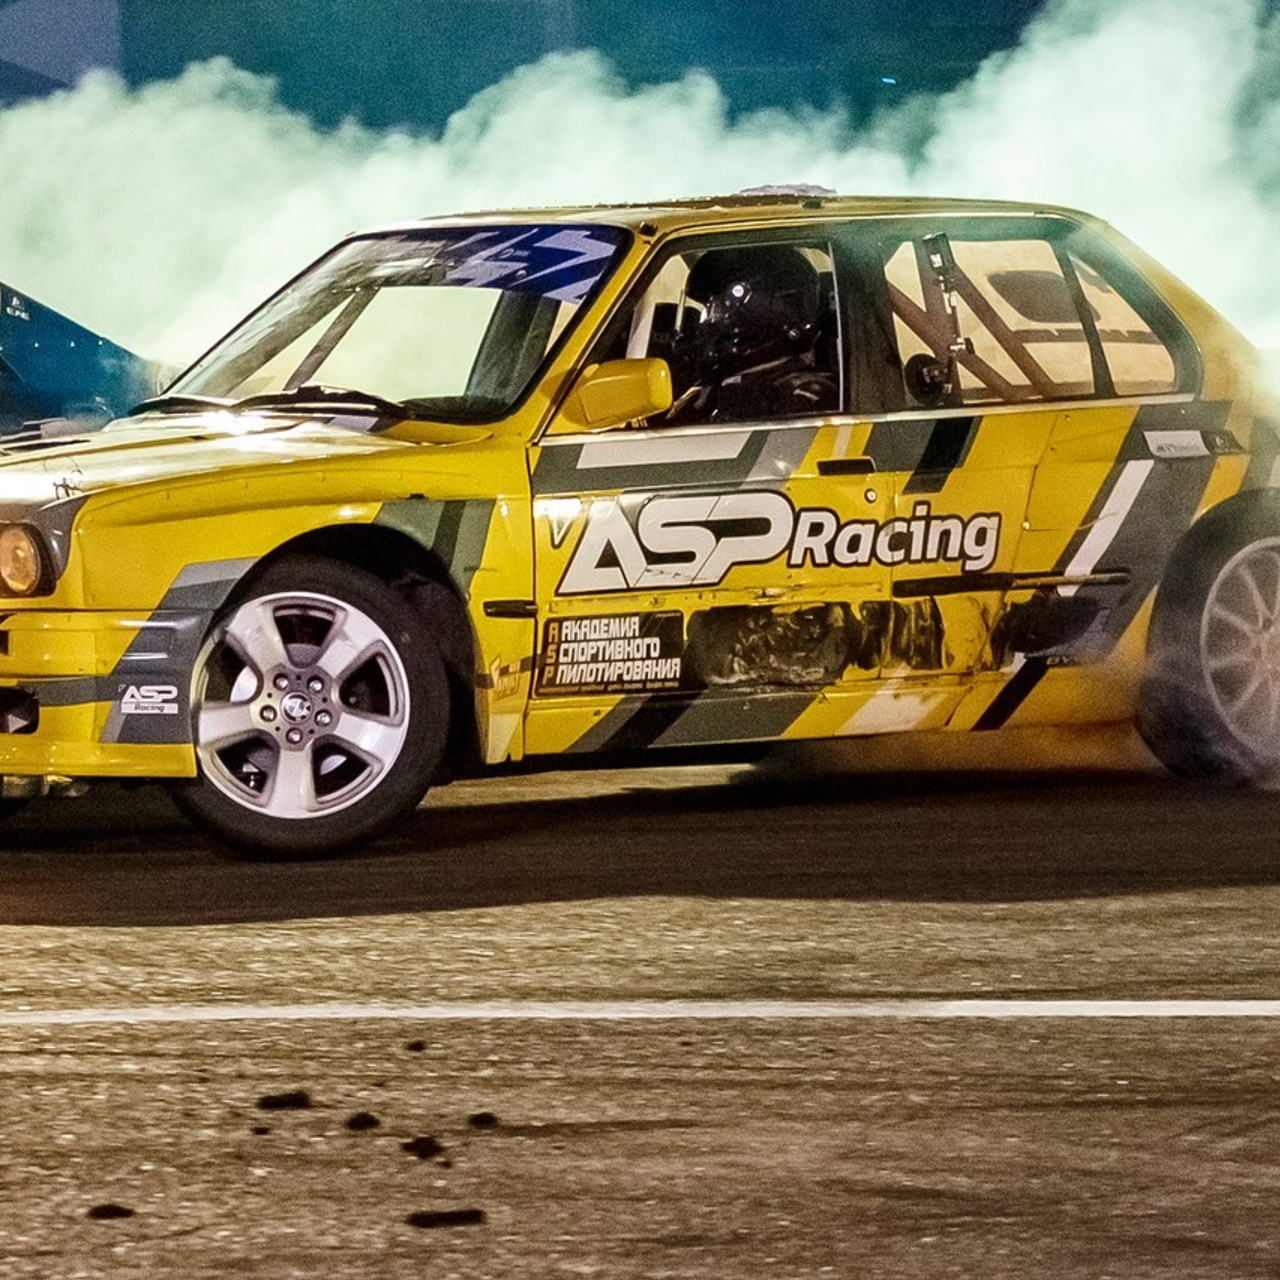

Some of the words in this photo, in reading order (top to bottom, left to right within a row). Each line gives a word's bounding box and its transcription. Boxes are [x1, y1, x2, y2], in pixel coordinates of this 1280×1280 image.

[555, 492, 794, 594] ASP
[789, 505, 1001, 571] Racing
[561, 616, 640, 641] АКАДЕМИЯ
[558, 637, 661, 664] СПОРТИВНОГО
[556, 657, 681, 685] ПИЛОТИРОВАНИЯ
[122, 685, 178, 703] ASP
[134, 704, 166, 713] Racing
